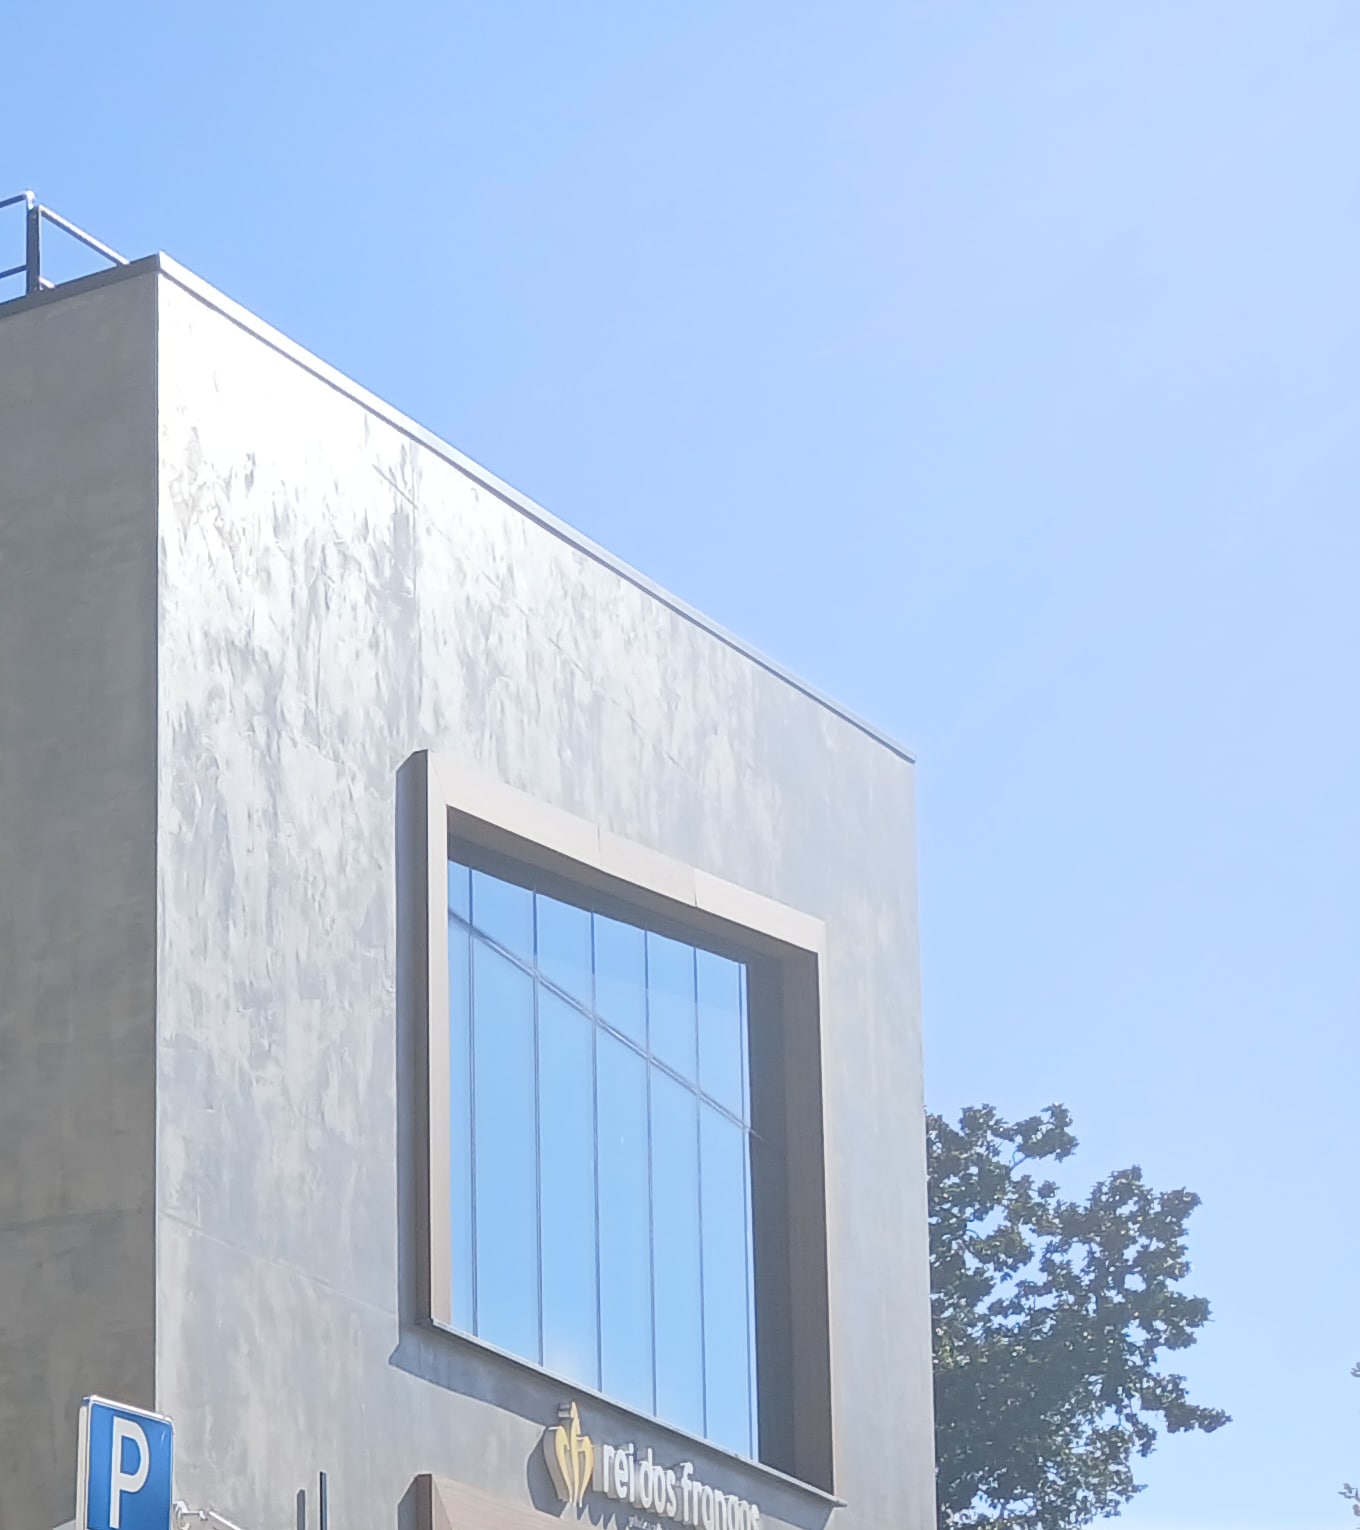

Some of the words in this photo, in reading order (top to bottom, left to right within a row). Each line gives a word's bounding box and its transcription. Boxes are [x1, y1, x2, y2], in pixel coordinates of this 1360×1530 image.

[109, 1415, 150, 1530] P
[602, 1443, 635, 1503] rei
[638, 1447, 677, 1518] dos
